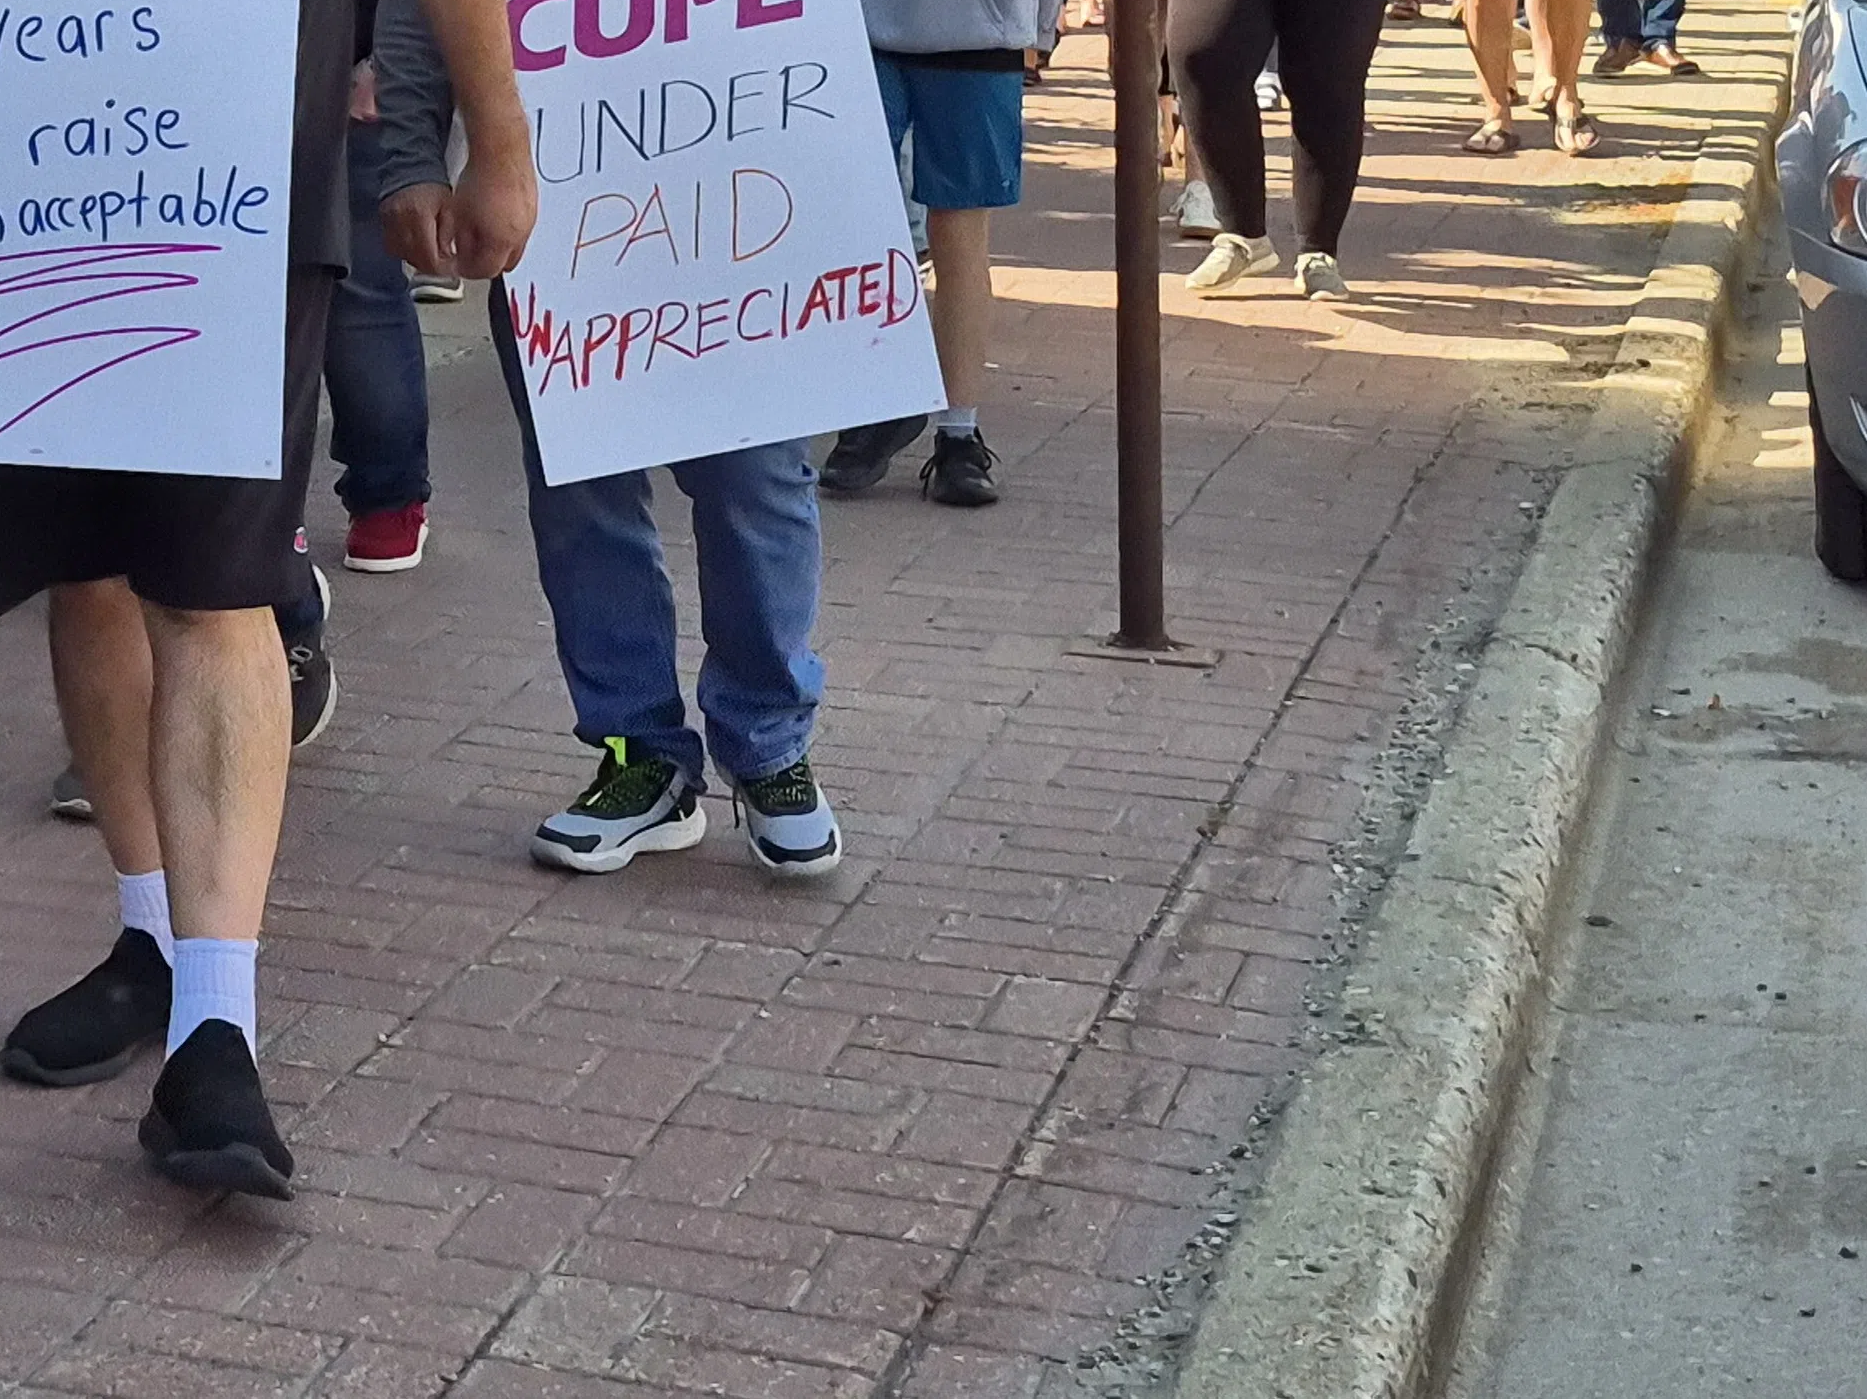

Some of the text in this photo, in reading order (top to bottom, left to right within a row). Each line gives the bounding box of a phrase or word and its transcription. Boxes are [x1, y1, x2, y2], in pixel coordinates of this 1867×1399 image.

[28, 99, 189, 167] raise
[535, 62, 835, 184] UNDER
[571, 169, 793, 280] PAID
[510, 248, 919, 397] UNAPPRECIATED
